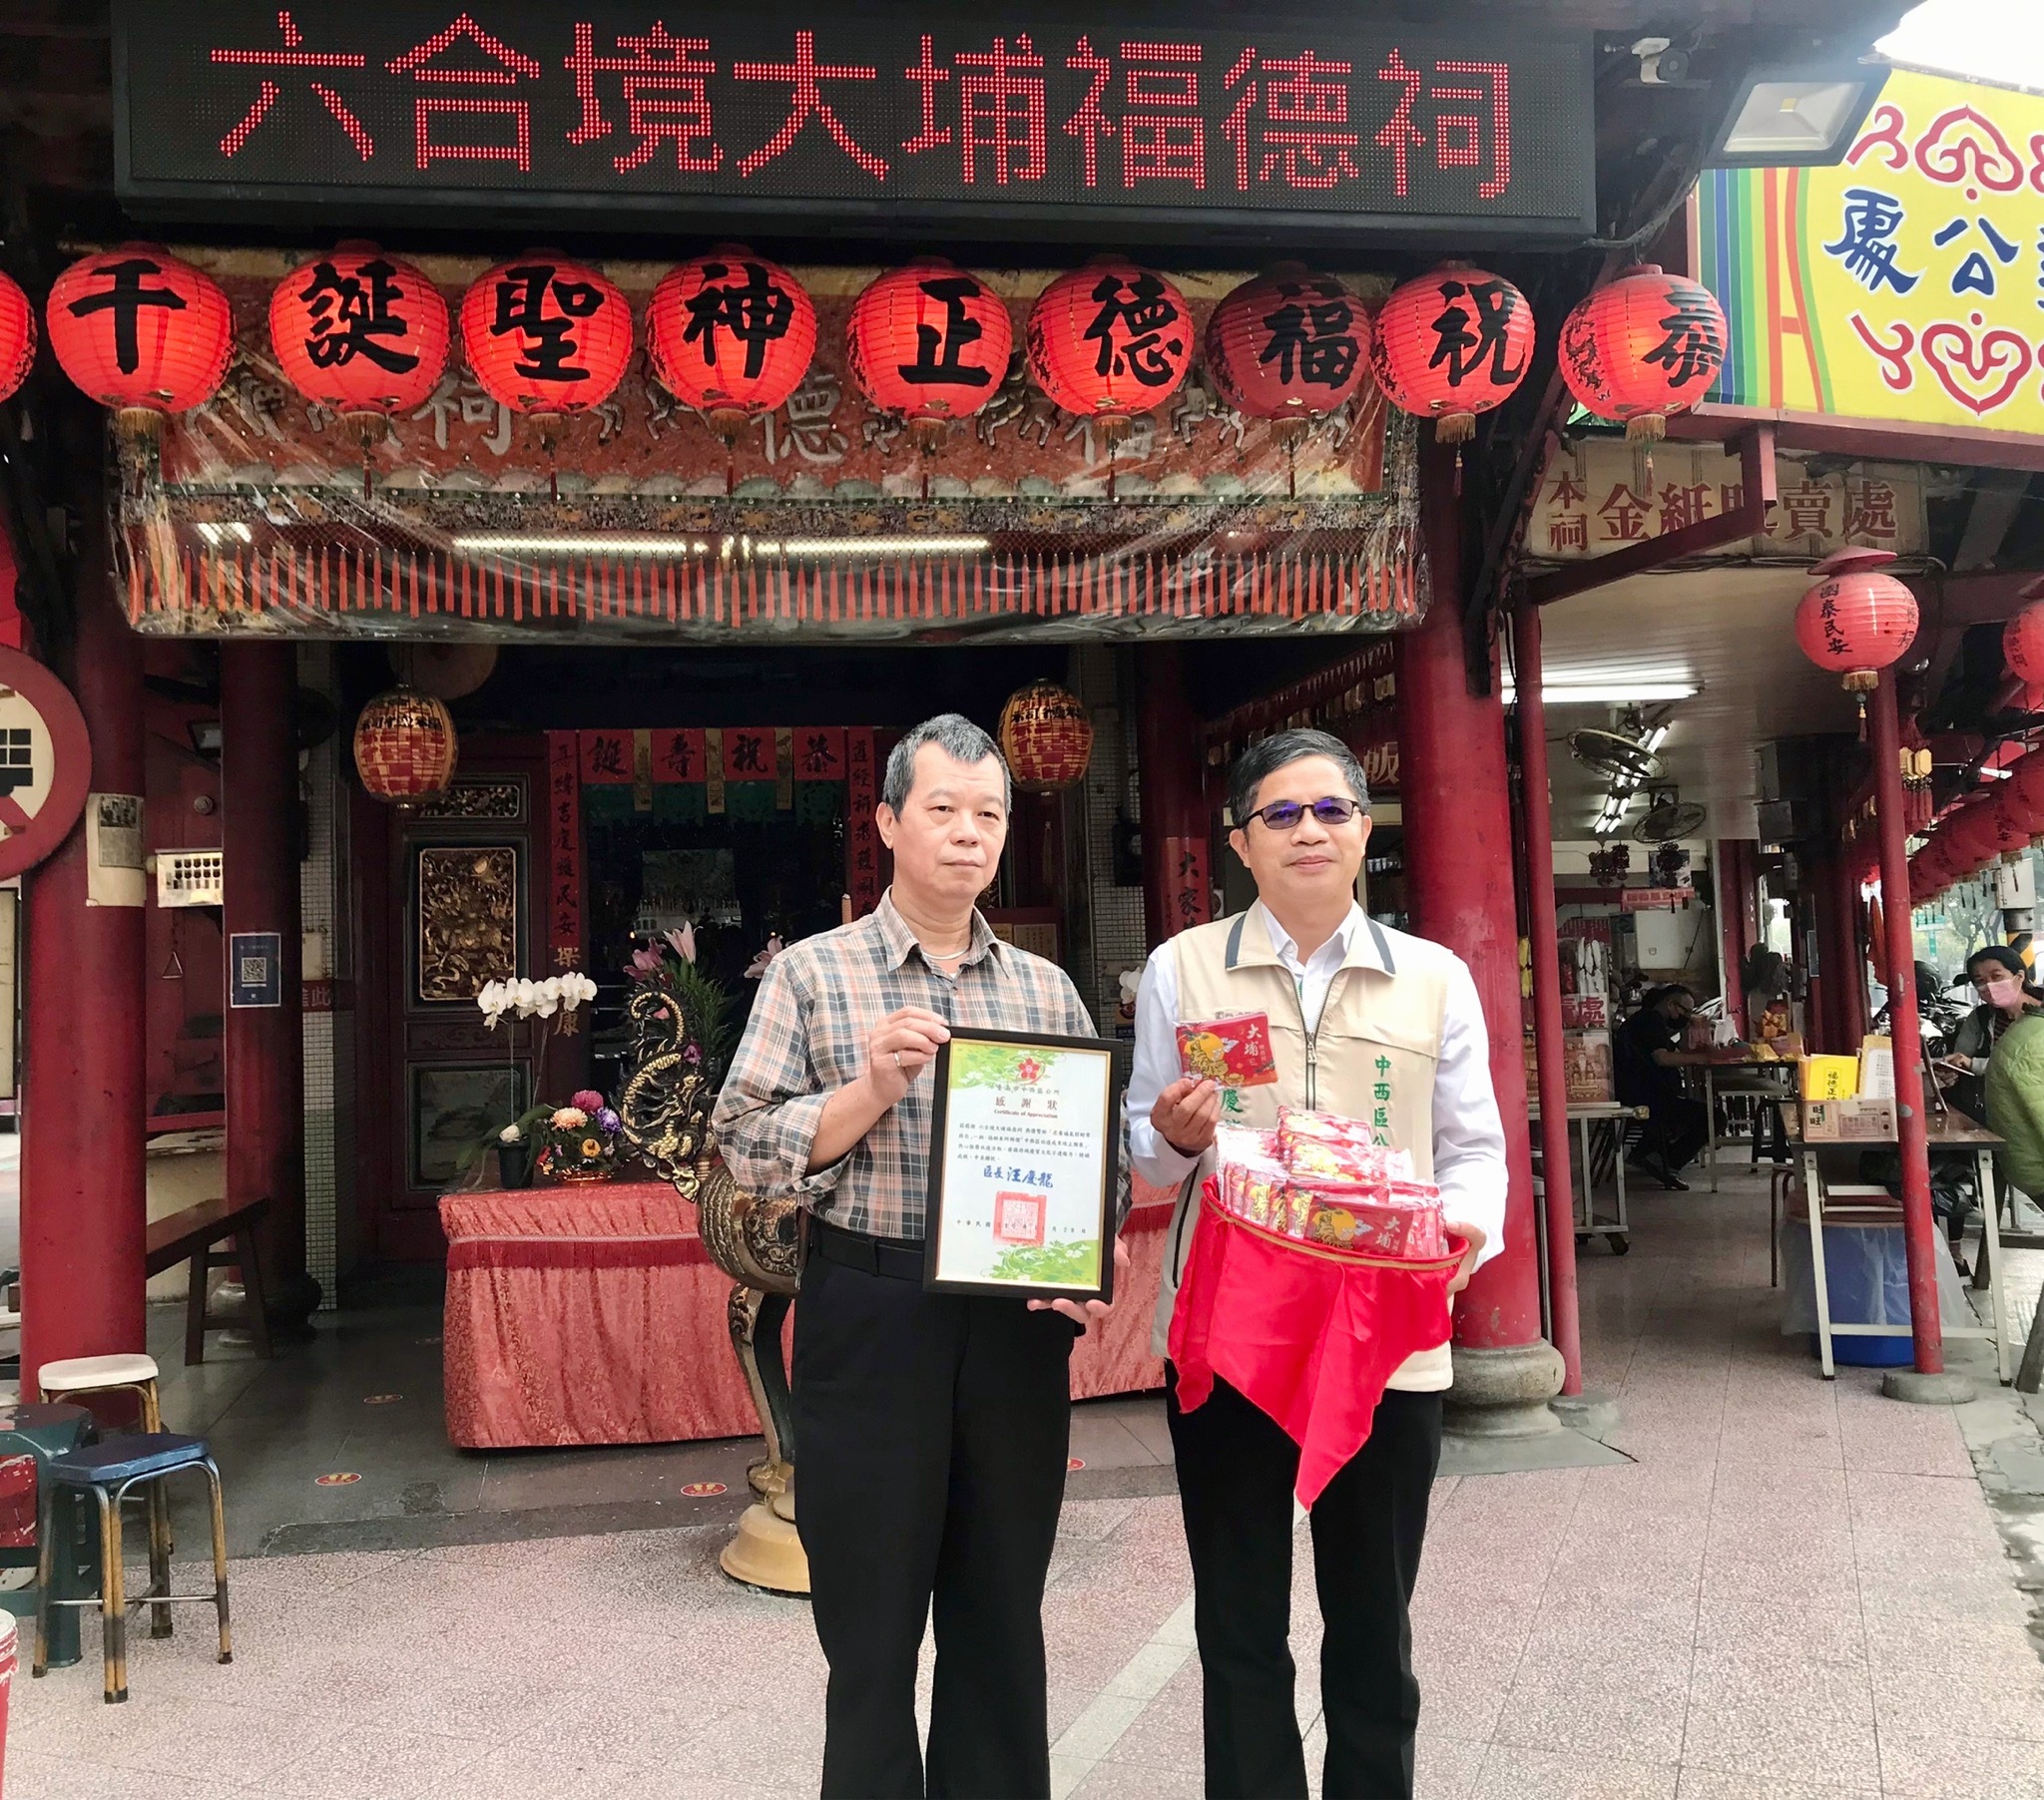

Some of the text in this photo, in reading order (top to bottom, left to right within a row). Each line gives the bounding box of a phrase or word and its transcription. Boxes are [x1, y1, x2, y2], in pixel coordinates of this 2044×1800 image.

[210, 11, 1510, 199] 六合境大埔福德祠
[1819, 583, 1852, 656] 國泰民安
[1245, 1024, 1263, 1057] 大埔
